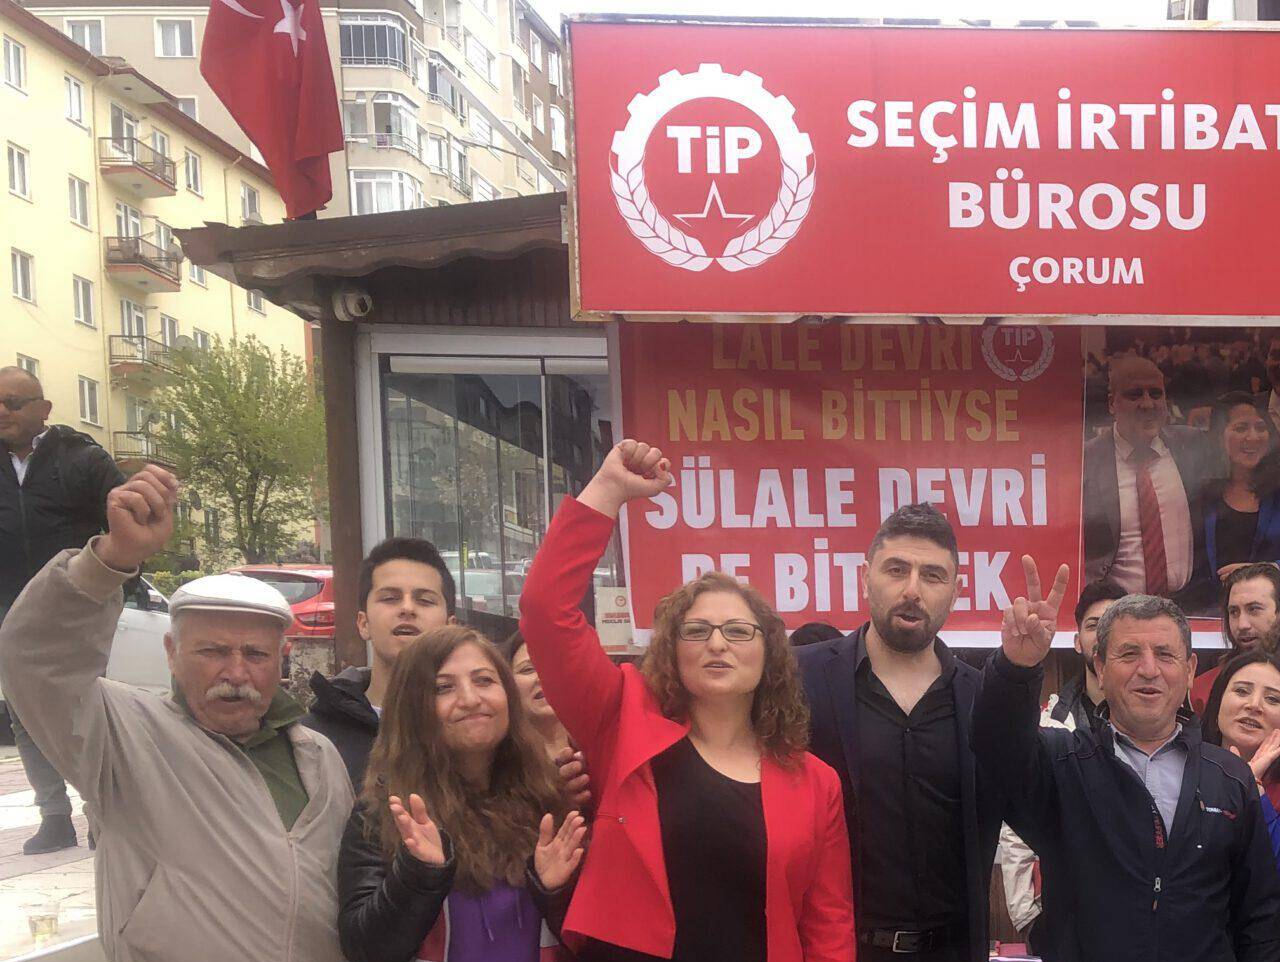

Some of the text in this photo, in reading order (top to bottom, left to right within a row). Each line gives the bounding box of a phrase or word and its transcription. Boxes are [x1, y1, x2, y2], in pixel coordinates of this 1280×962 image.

[846, 86, 1041, 164] SEÇİM
[949, 168, 1206, 231] BÜROSU
[1009, 256, 1144, 292] ÇORUM
[711, 324, 823, 371] LALE
[667, 378, 1020, 442] NASIL BİTTİYSE
[645, 453, 1048, 530] SÜLALE DEVRİ
[774, 537, 1013, 612] BİTEK
